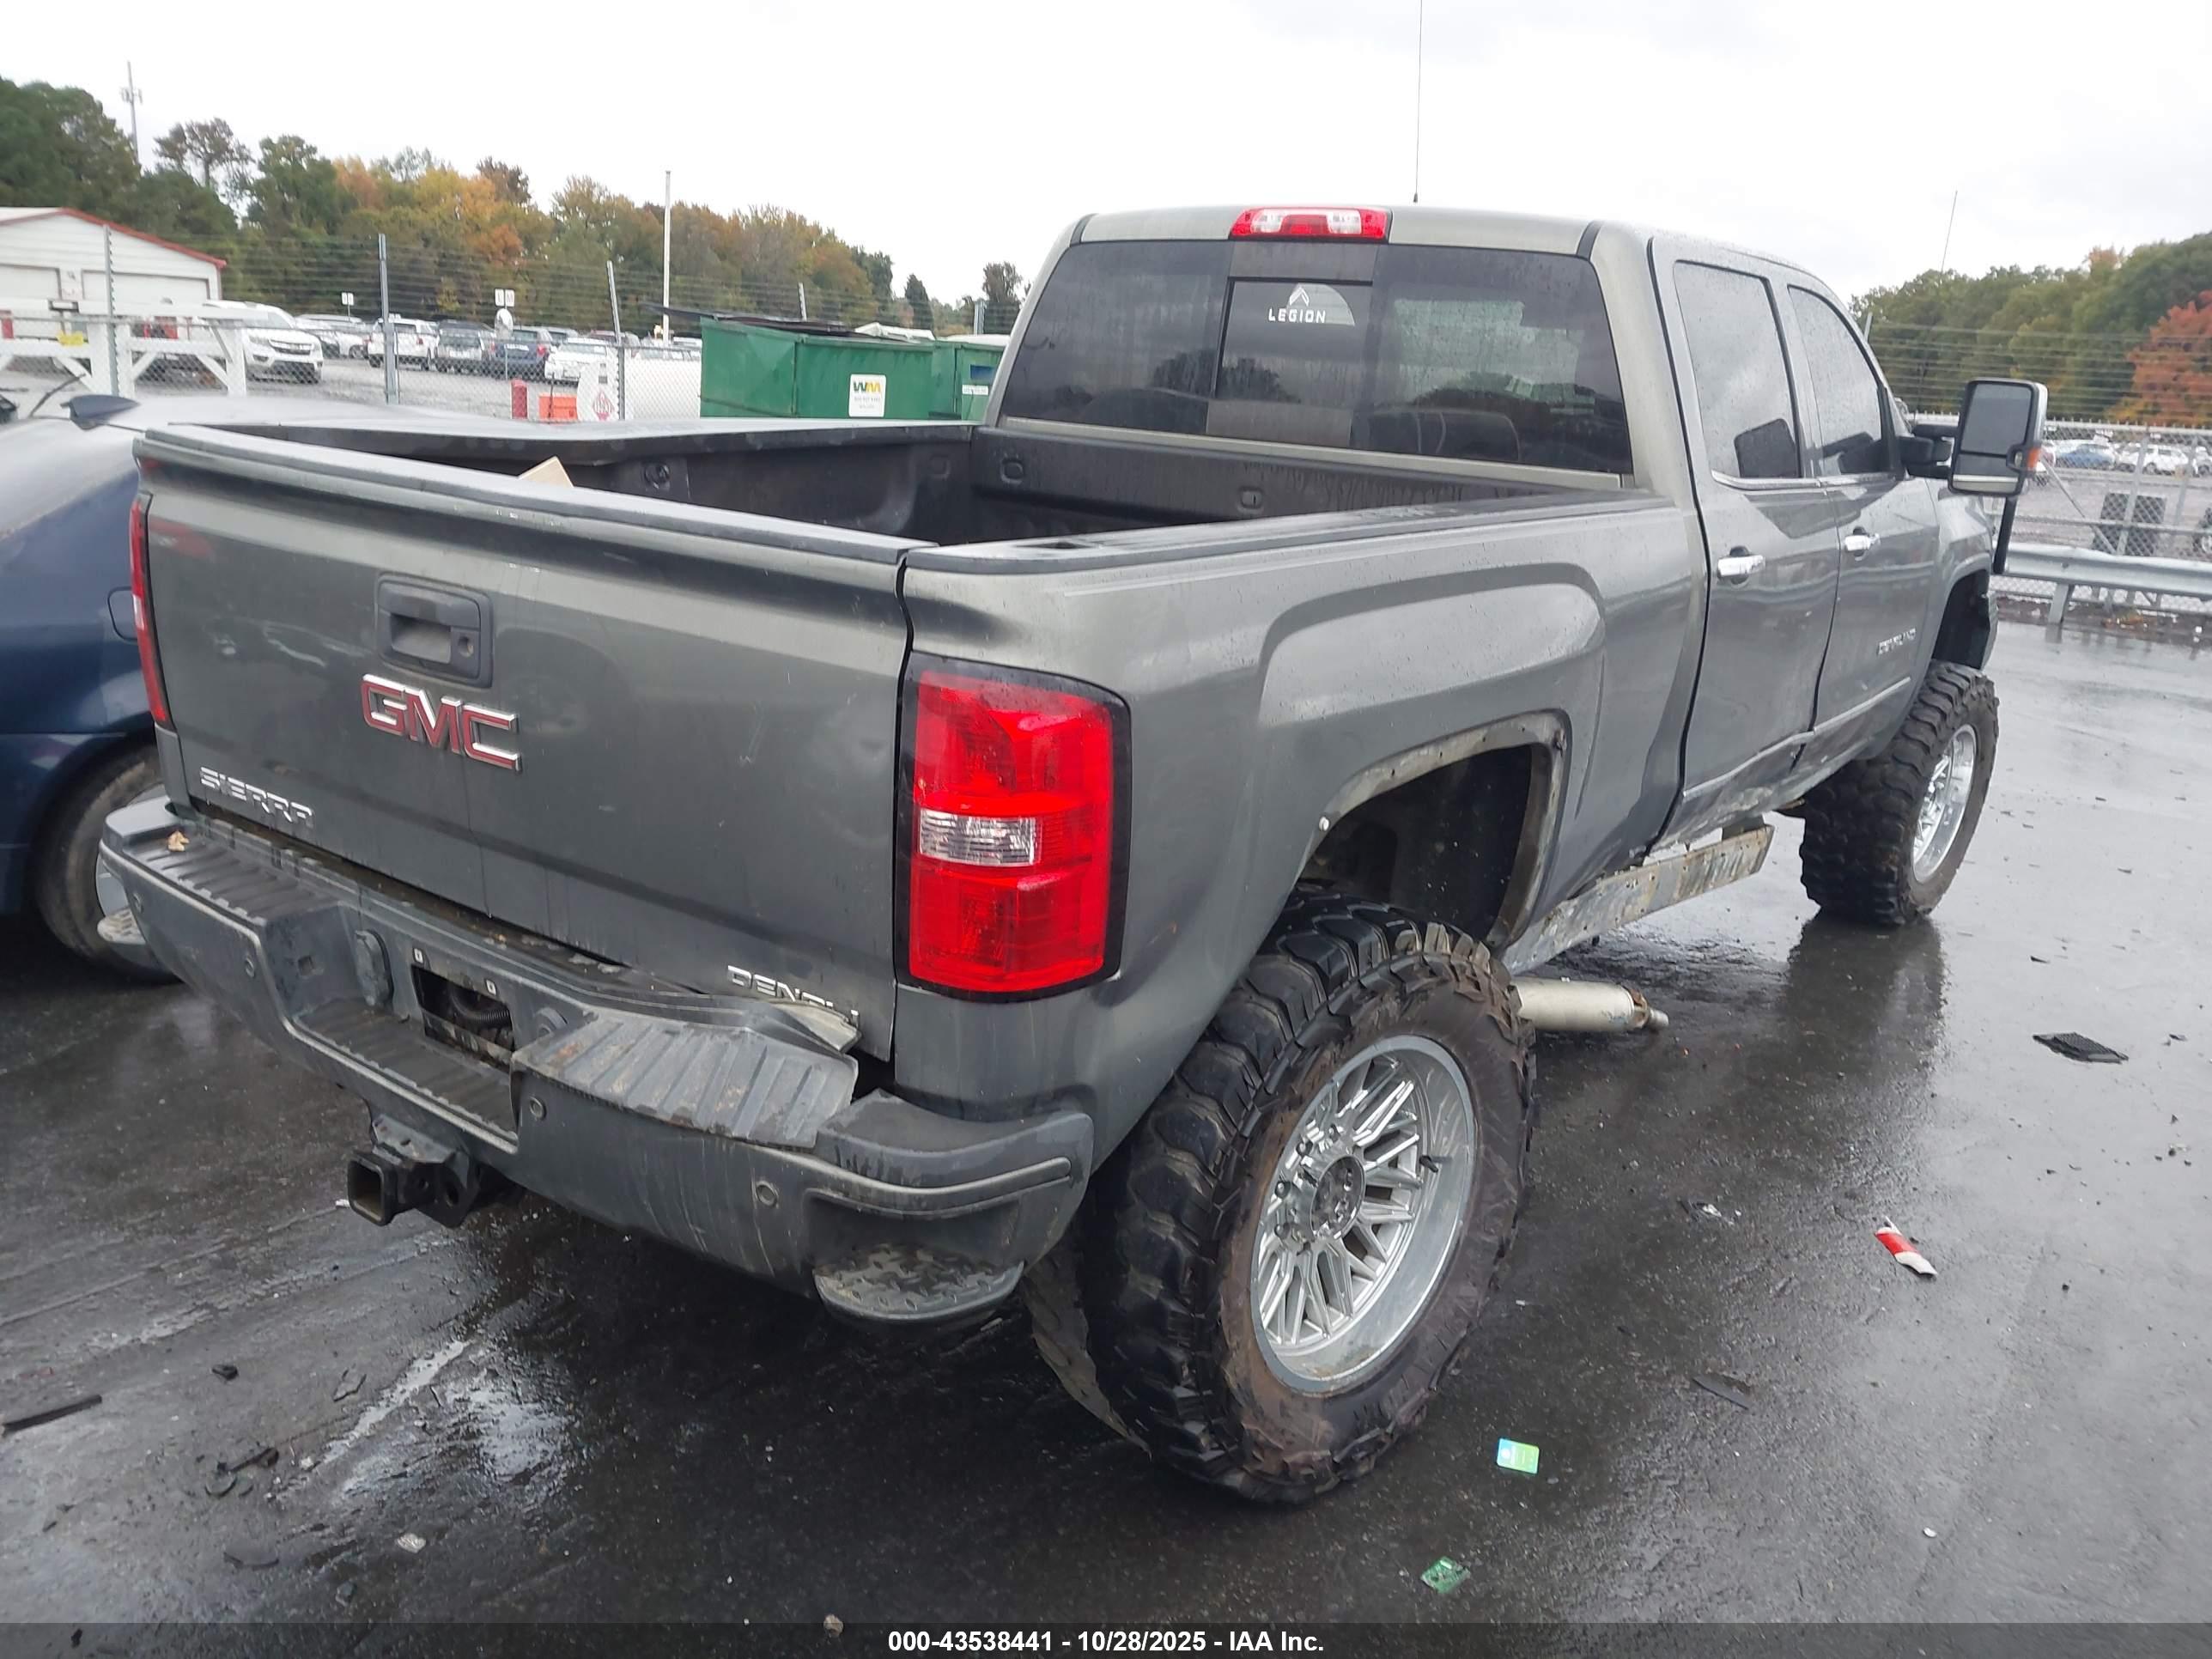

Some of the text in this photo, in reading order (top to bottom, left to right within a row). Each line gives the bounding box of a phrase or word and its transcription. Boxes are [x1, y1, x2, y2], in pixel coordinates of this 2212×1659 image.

[1268, 307, 1326, 324] LEGION
[853, 380, 881, 392] WM
[361, 673, 522, 772] GMC
[199, 766, 314, 829] SIERRA
[727, 964, 860, 1030] DENI
